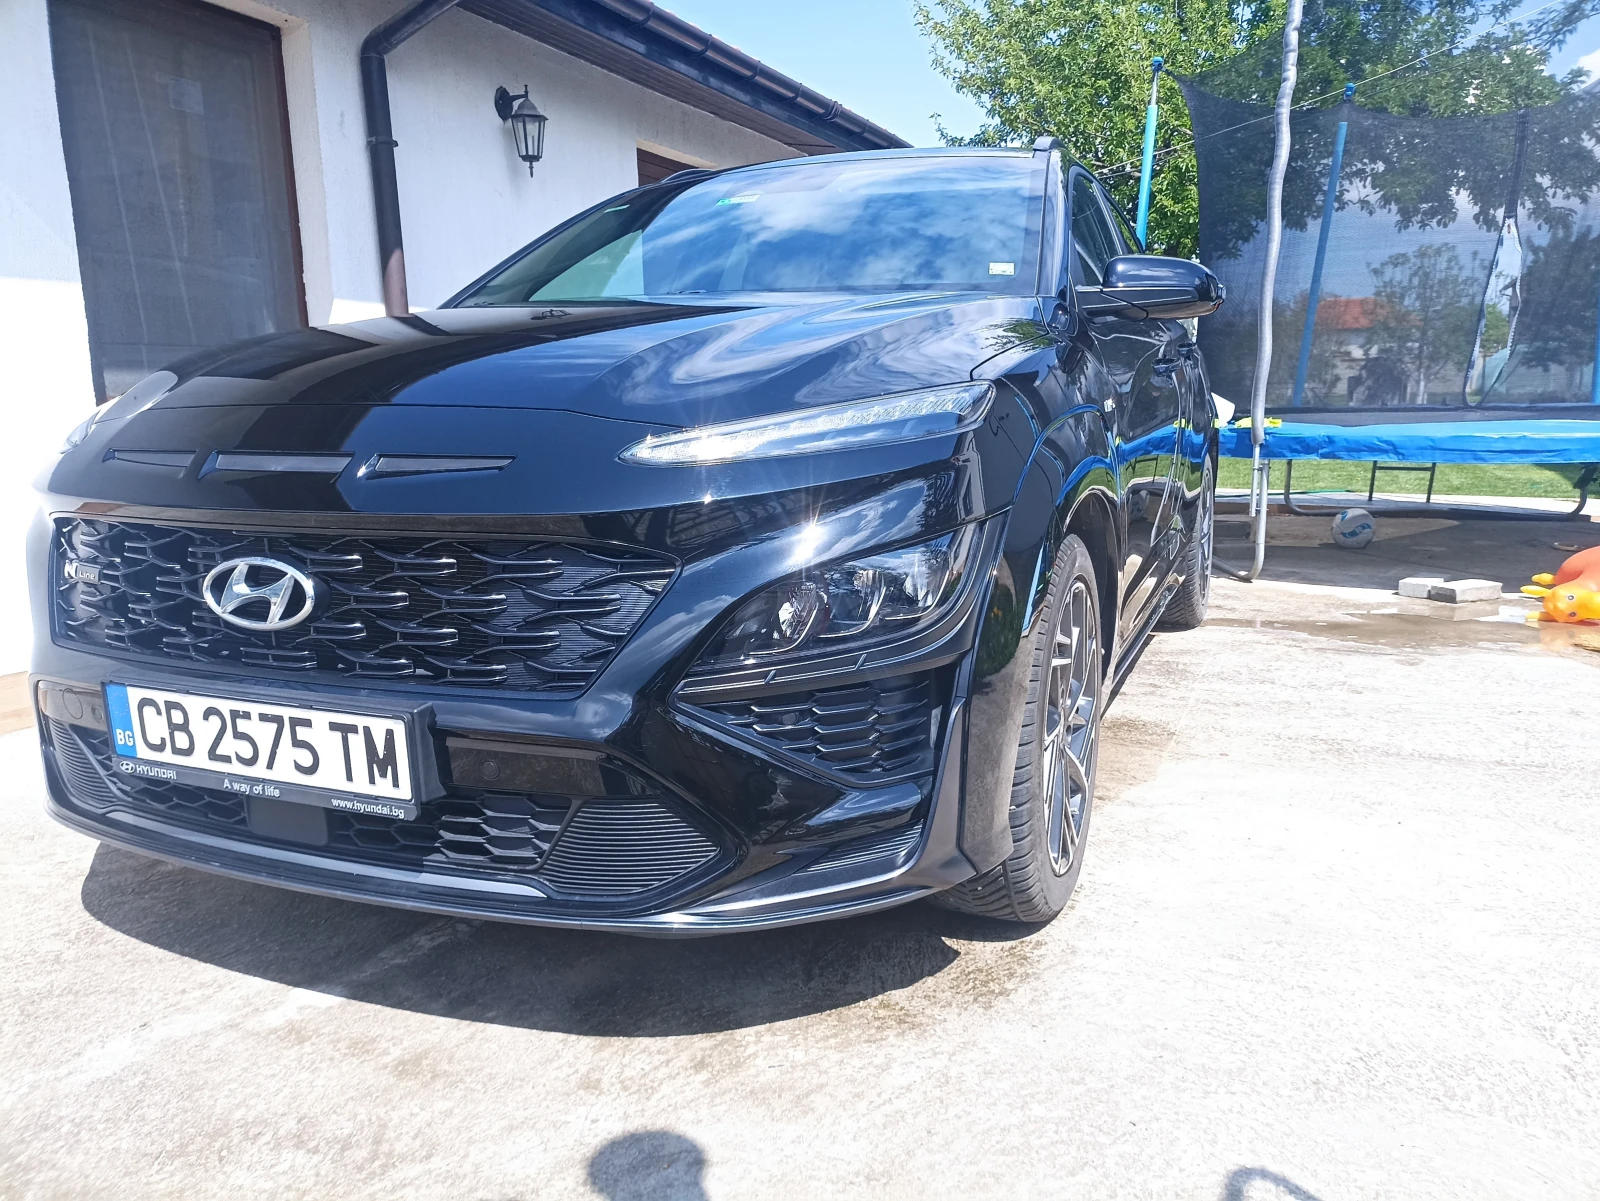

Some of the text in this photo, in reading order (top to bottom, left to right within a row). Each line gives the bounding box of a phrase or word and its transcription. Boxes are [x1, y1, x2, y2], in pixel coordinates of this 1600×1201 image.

[116, 728, 134, 747] BG
[137, 697, 400, 788] CB 2575 TM
[136, 764, 177, 780] HYUNDAI
[223, 779, 280, 798] A way of life
[331, 797, 405, 818] www.hyundai.bg
